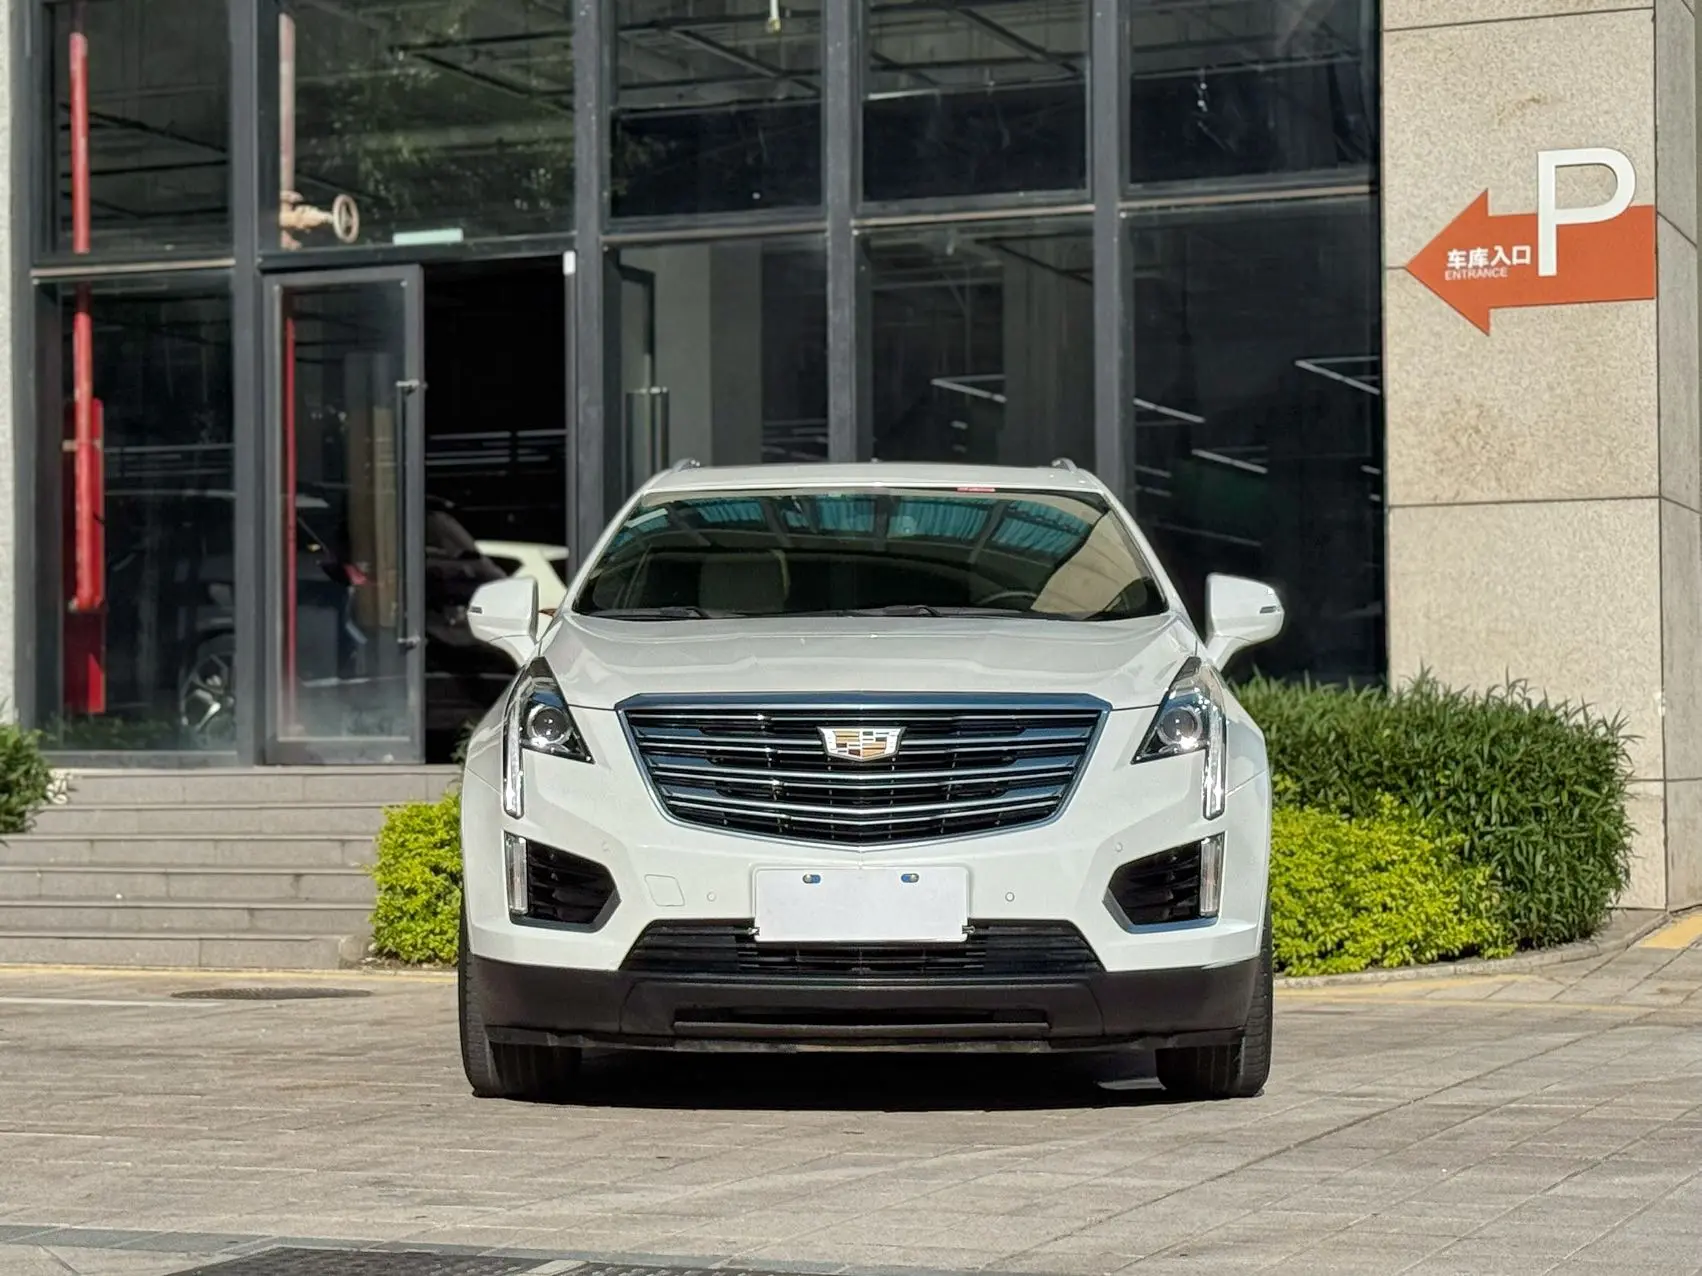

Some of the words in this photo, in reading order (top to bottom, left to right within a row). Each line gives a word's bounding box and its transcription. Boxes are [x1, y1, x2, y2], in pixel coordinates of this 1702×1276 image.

[1538, 147, 1636, 276] P
[1446, 245, 1531, 269] 车库入口
[1444, 267, 1508, 281] ENTRANCE
